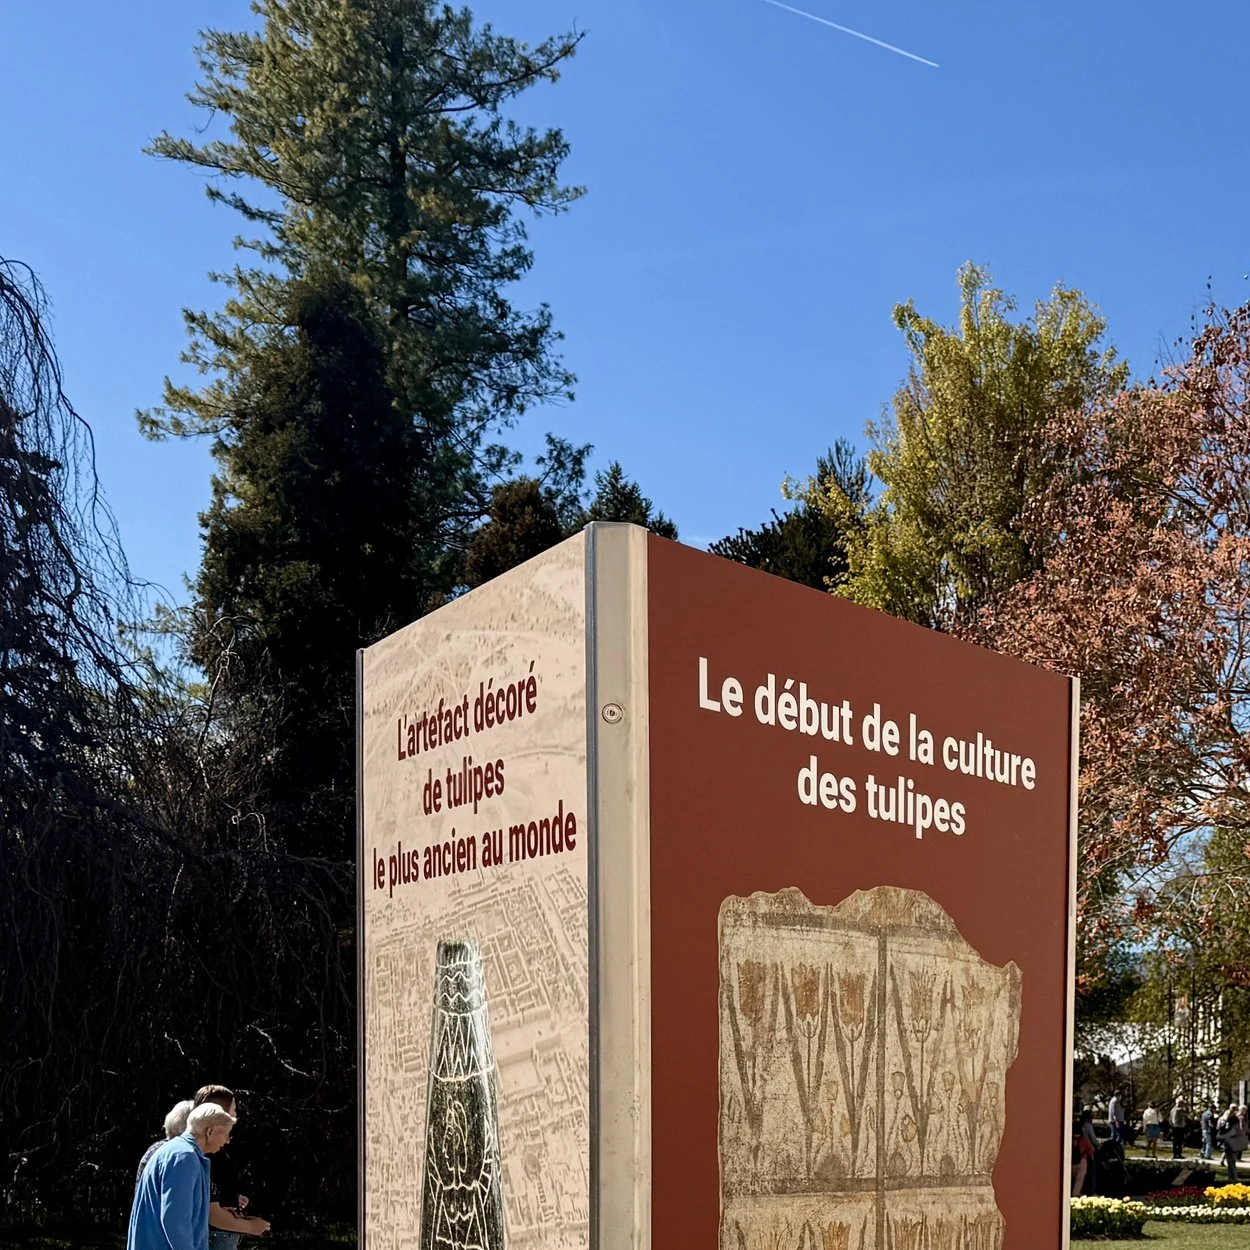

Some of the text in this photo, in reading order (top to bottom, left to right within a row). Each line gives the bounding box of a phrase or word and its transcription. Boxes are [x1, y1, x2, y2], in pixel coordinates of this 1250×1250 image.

[398, 660, 537, 761] L'artefact décoré
[699, 656, 1036, 790] Le début de la culture
[423, 756, 504, 816] de tulipes
[798, 755, 965, 839] des tulipes
[373, 800, 576, 898] le plus ancien au monde
